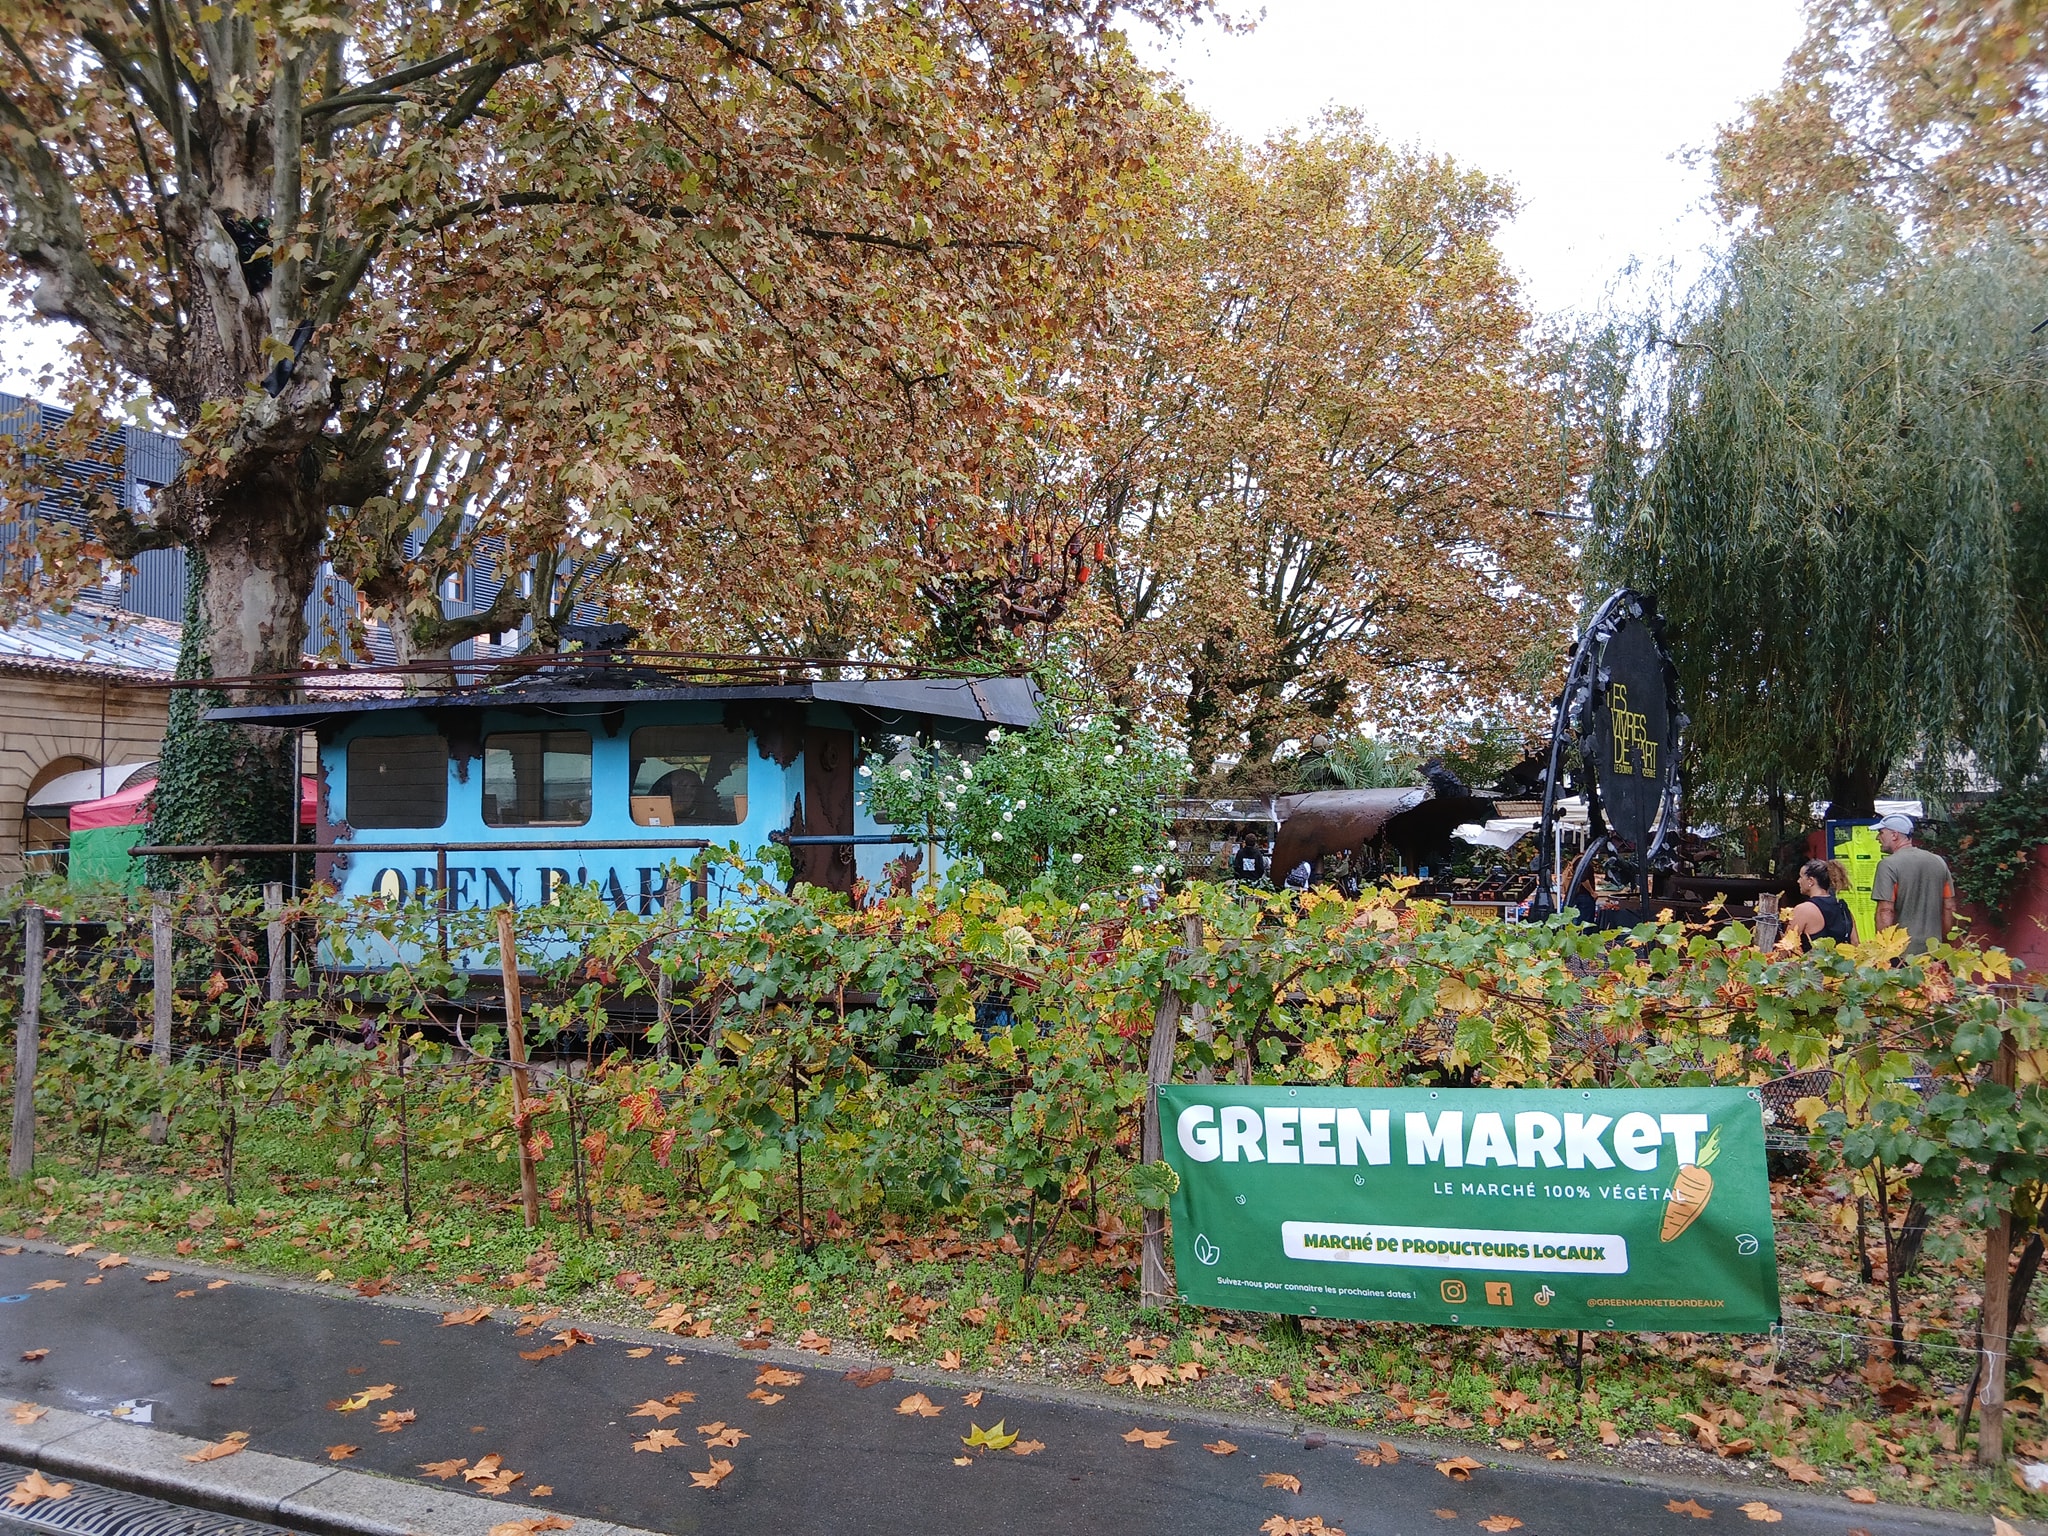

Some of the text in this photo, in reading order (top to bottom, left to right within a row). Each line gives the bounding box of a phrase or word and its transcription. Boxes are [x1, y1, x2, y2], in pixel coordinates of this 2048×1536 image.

[1610, 707, 1647, 746] VIVRES
[1614, 735, 1630, 764] DE
[371, 866, 521, 911] OPEN
[1176, 1104, 1391, 1166] GREEN
[1433, 1181, 1687, 1201] LE MARCHÉ 100% VÉGÉTAL
[1217, 1276, 1263, 1288] Suivez-nous
[1264, 1282, 1283, 1290] pour
[1325, 1285, 1337, 1294] les
[1338, 1287, 1385, 1298] prochaines
[1387, 1290, 1412, 1299] dates
[1586, 1298, 1725, 1308] @GREENMARKETBORDEAUX
